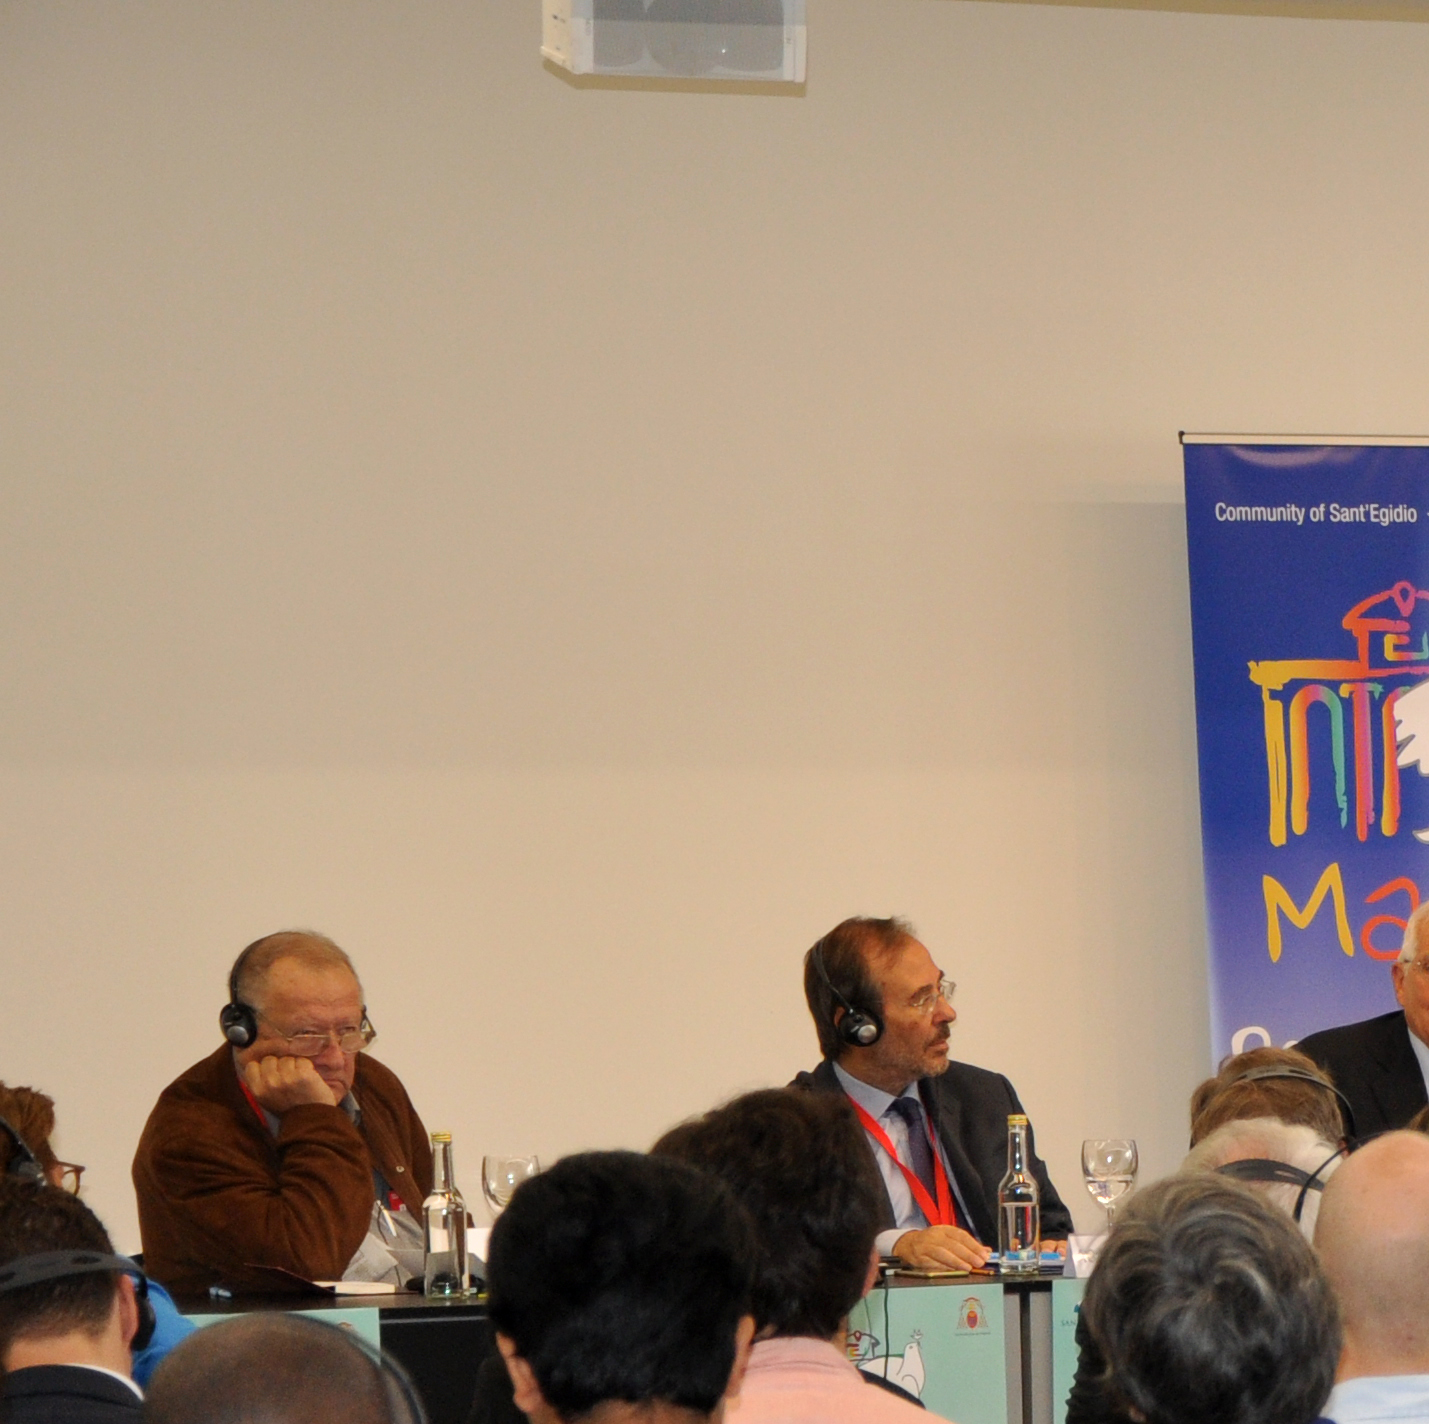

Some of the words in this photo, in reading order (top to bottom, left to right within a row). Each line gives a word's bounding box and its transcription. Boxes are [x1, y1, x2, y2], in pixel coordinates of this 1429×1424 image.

[1215, 502, 1305, 525] Community
[1309, 503, 1325, 522] of
[1329, 503, 1418, 526] Sant'Egidio
